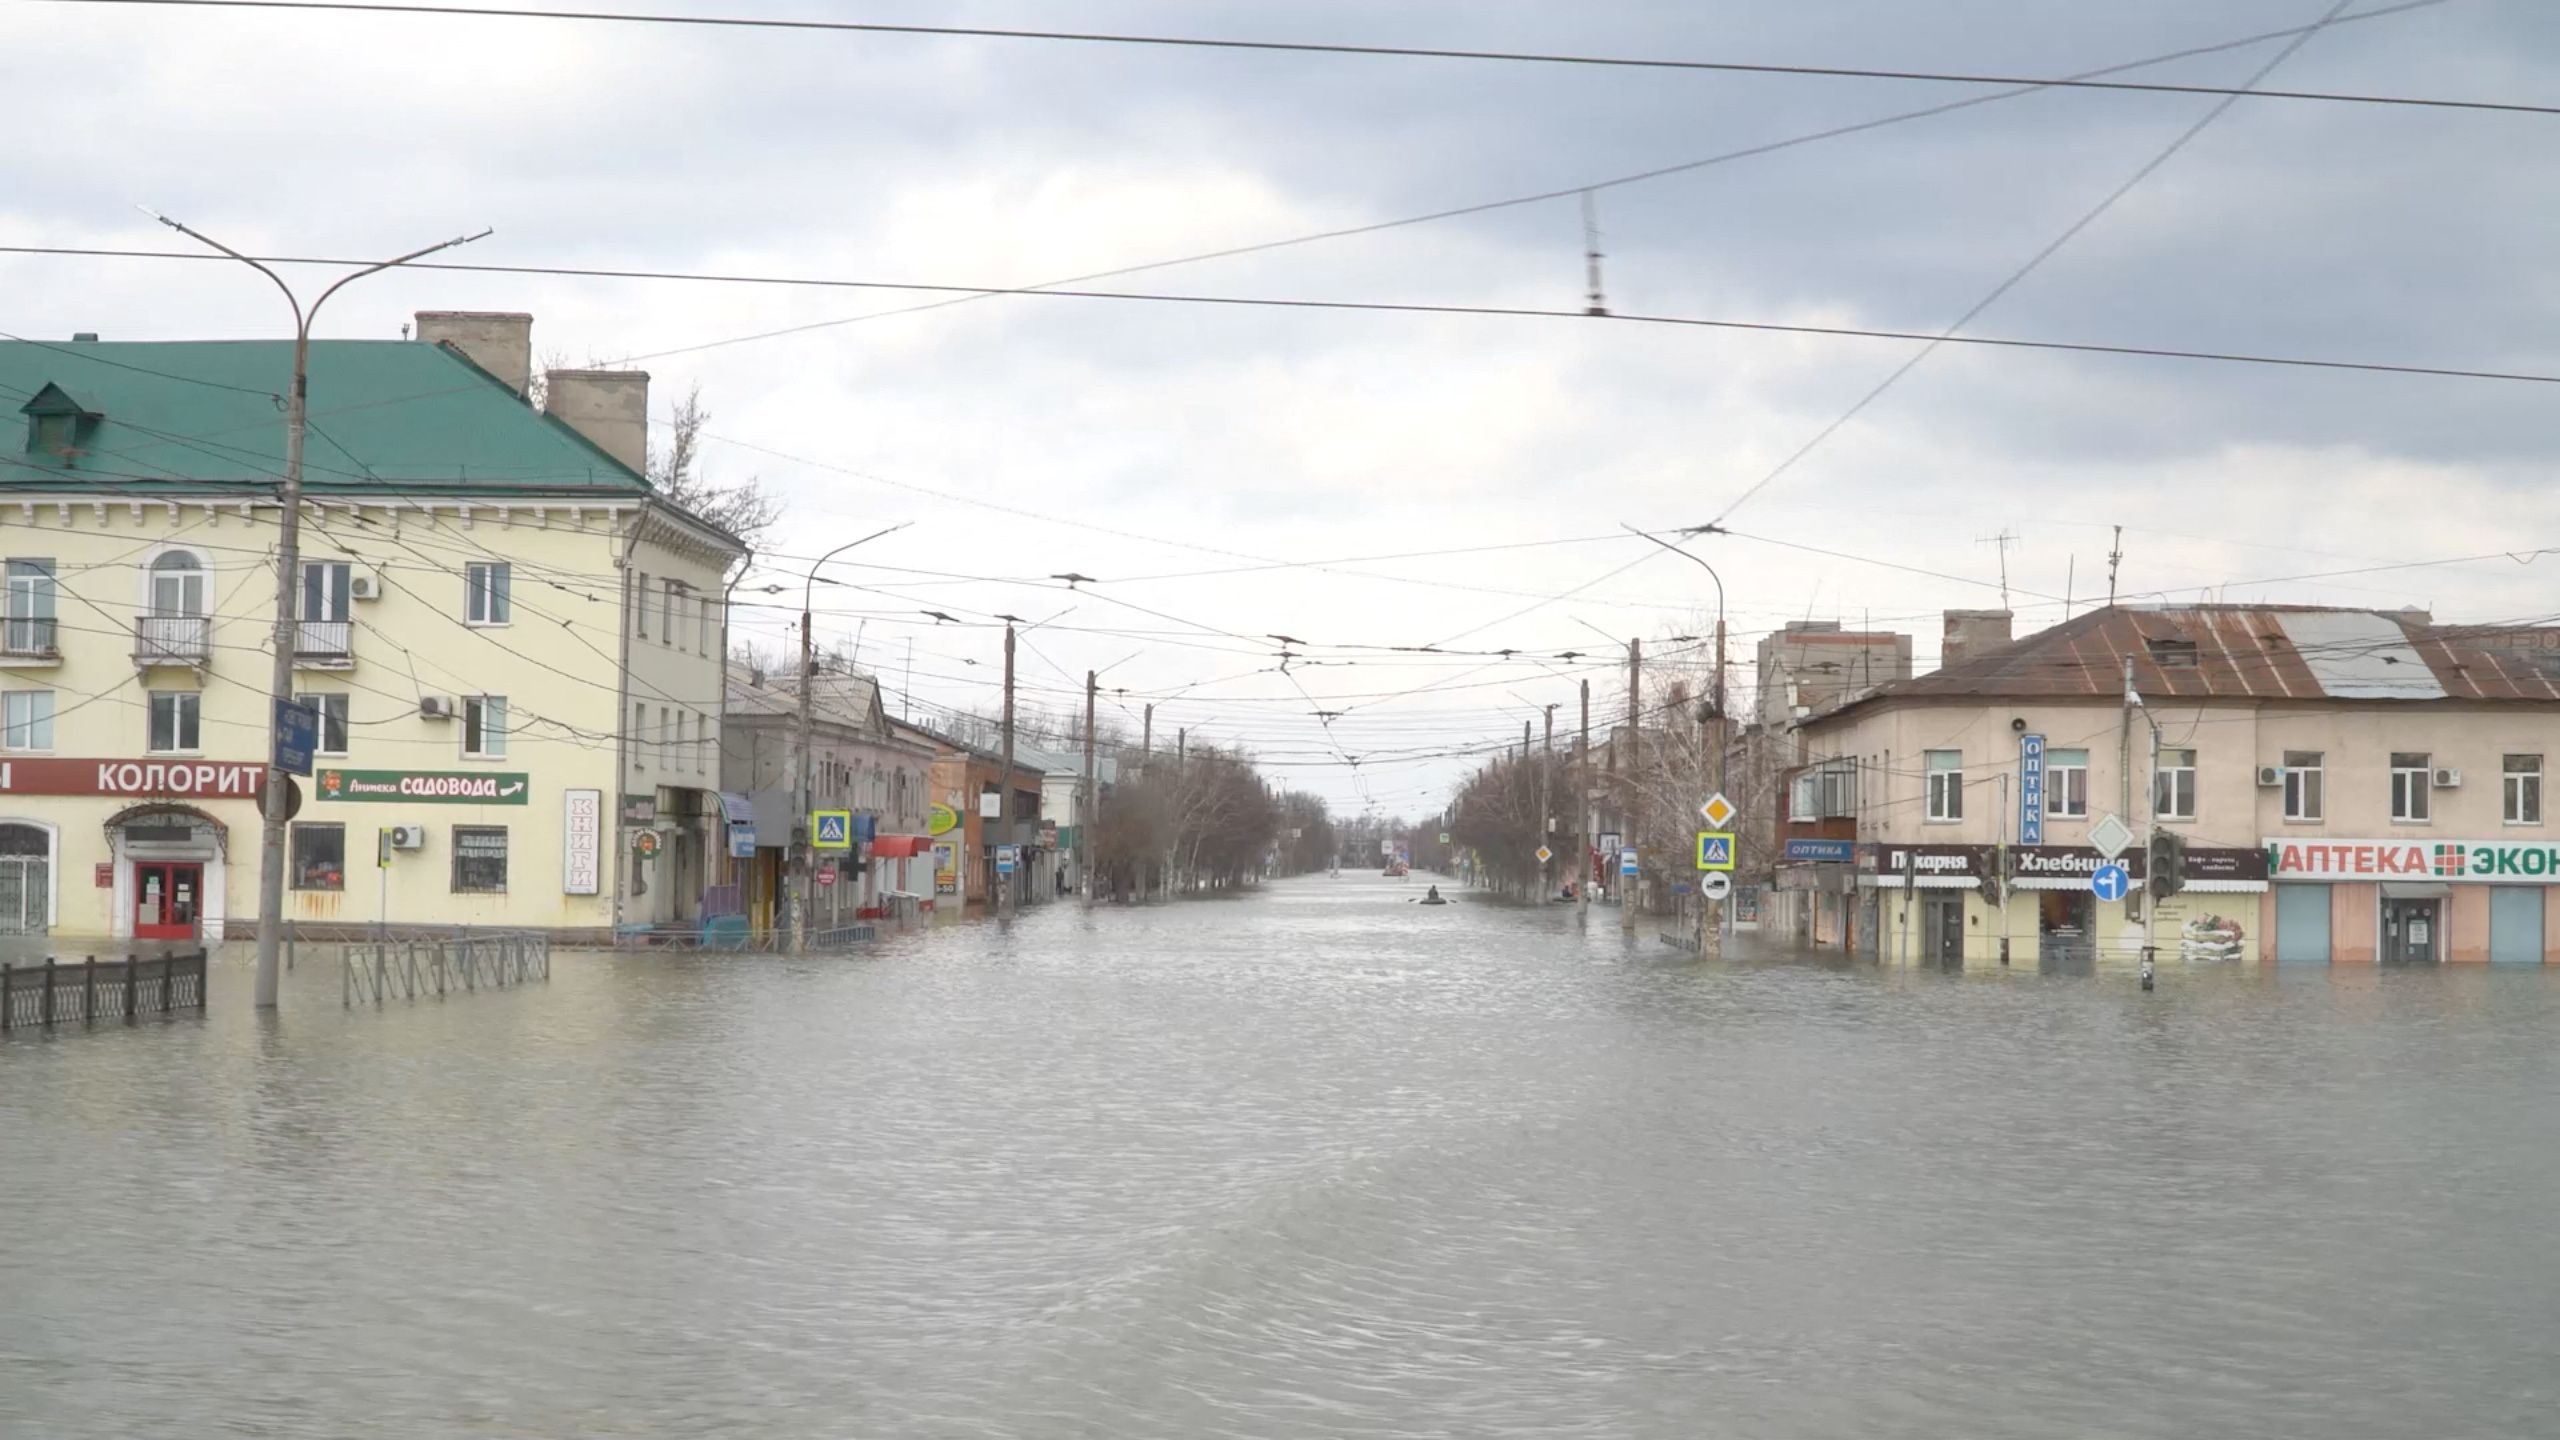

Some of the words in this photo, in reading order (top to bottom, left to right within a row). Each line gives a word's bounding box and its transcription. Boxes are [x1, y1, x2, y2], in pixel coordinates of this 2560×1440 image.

[98, 763, 263, 794] КОЛОРИТ
[349, 778, 397, 794] Аптека
[2025, 742, 2040, 840] ОПТИКА
[571, 798, 593, 885] КНИГИ
[1791, 844, 1843, 856] ОПТИКА
[1891, 850, 1969, 874] Пкарня
[2279, 845, 2428, 875] АПТЕКА
